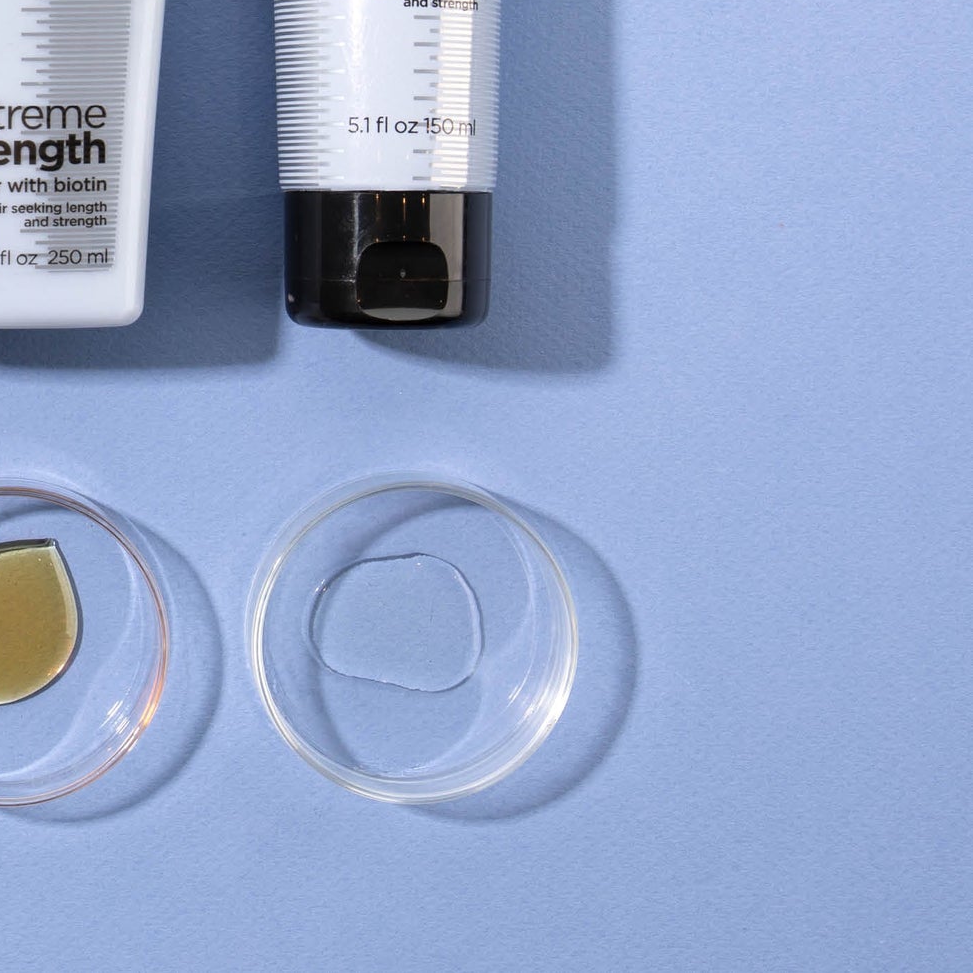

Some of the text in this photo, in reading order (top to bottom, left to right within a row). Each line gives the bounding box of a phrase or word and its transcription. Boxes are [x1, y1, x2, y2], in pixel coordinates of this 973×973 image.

[348, 116, 476, 136] 5.1 fl oz 150 ml
[8, 178, 48, 193] with
[54, 177, 107, 192] biotin
[11, 202, 62, 216] seeking
[66, 201, 107, 215] length
[24, 215, 107, 229] and strength
[0, 250, 12, 265] fl
[16, 253, 38, 265] oz
[48, 250, 82, 265] 250
[87, 248, 108, 264] ml
